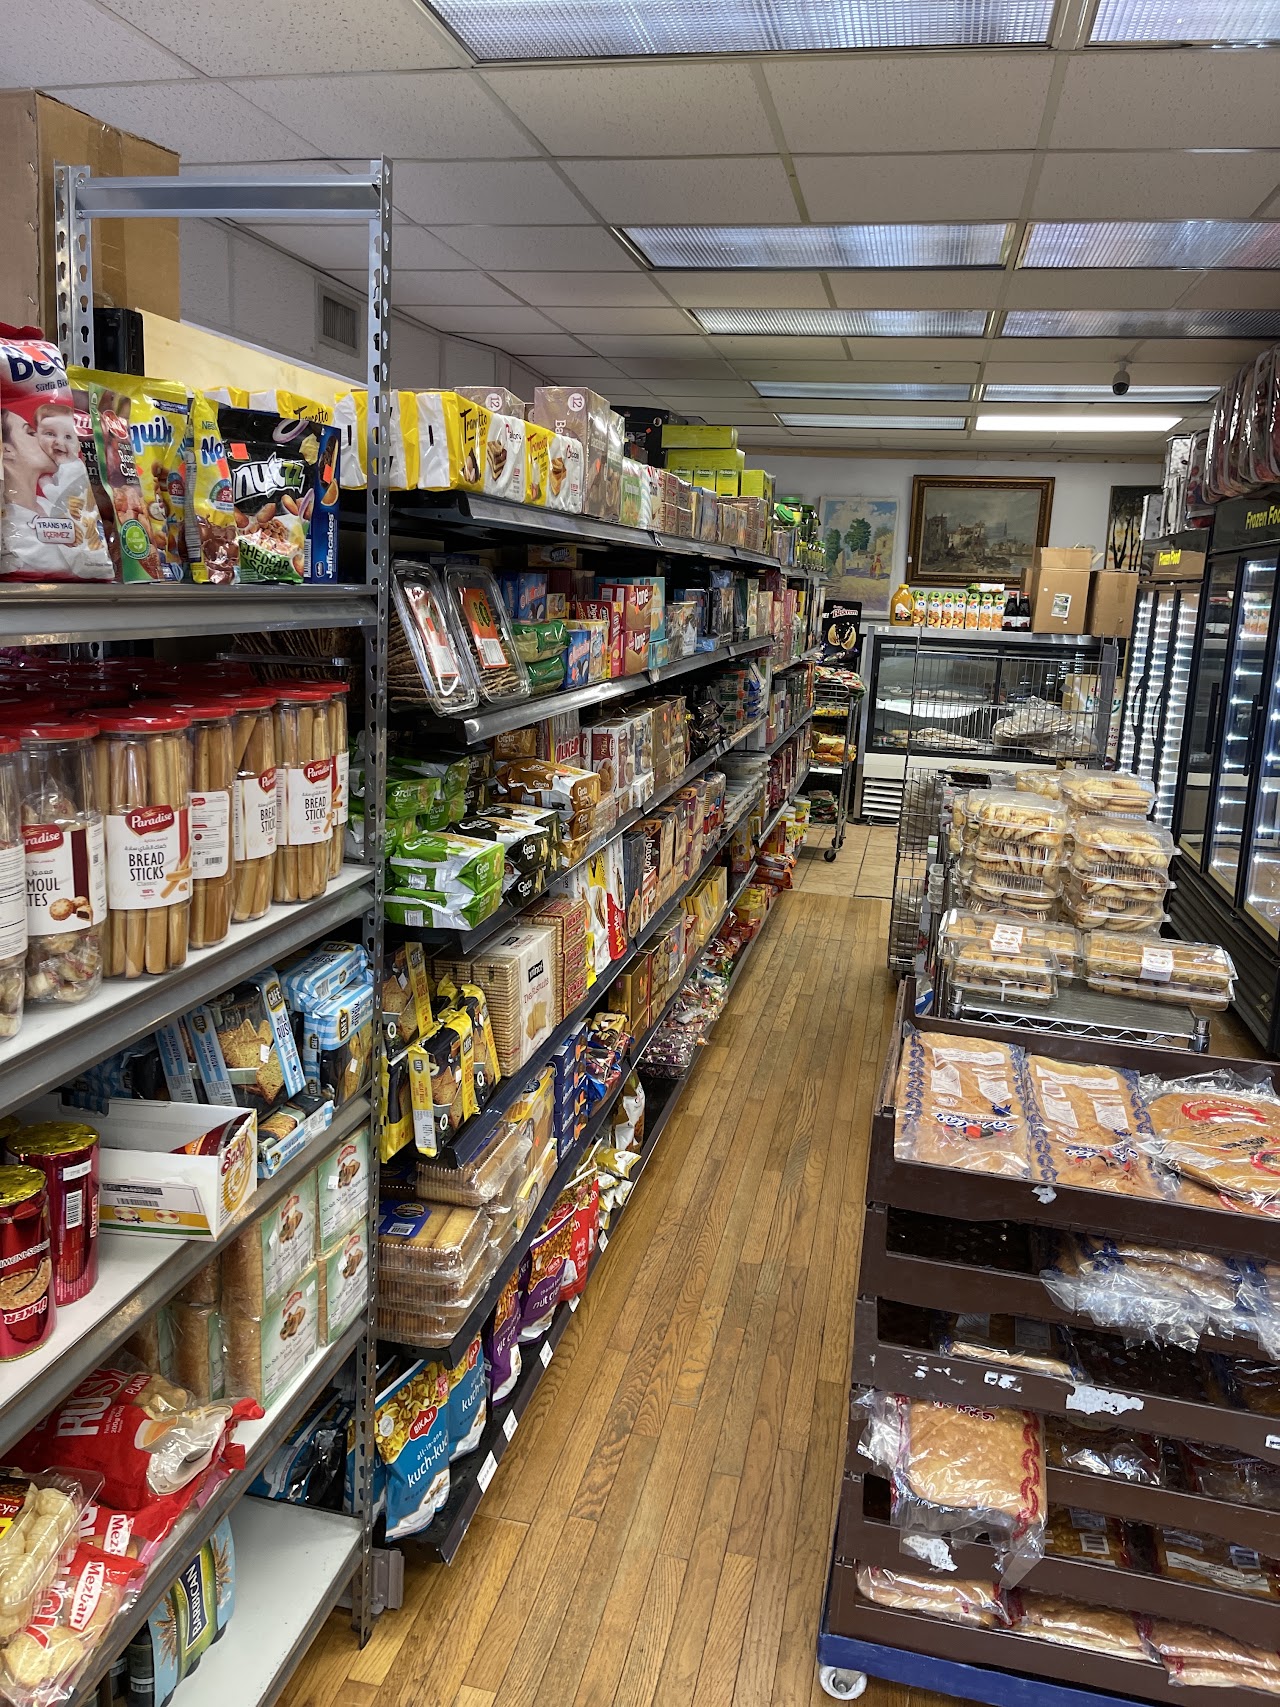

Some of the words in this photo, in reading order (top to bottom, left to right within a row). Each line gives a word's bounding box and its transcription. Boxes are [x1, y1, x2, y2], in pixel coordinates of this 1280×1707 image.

[572, 397, 583, 409] 12
[38, 522, 60, 531] TRANS
[60, 521, 73, 530] YAĞ
[1245, 511, 1268, 530] Frozen
[43, 531, 70, 540] İÇERMEZ
[555, 736, 580, 763] ÜLKER
[304, 796, 327, 809] BREAD
[131, 812, 172, 829] Paradise
[305, 808, 326, 821] STICKS
[523, 843, 536, 855] Greta
[128, 853, 165, 867] BREAD
[130, 867, 164, 881] STICKS
[3, 1296, 48, 1325] ÜLKER
[125, 1375, 151, 1395] PLAIN
[413, 1411, 434, 1435] BIKAJI
[417, 1430, 443, 1461] all-in-one
[73, 1561, 102, 1629] Mezban
[186, 1563, 203, 1638] BARBICAN
